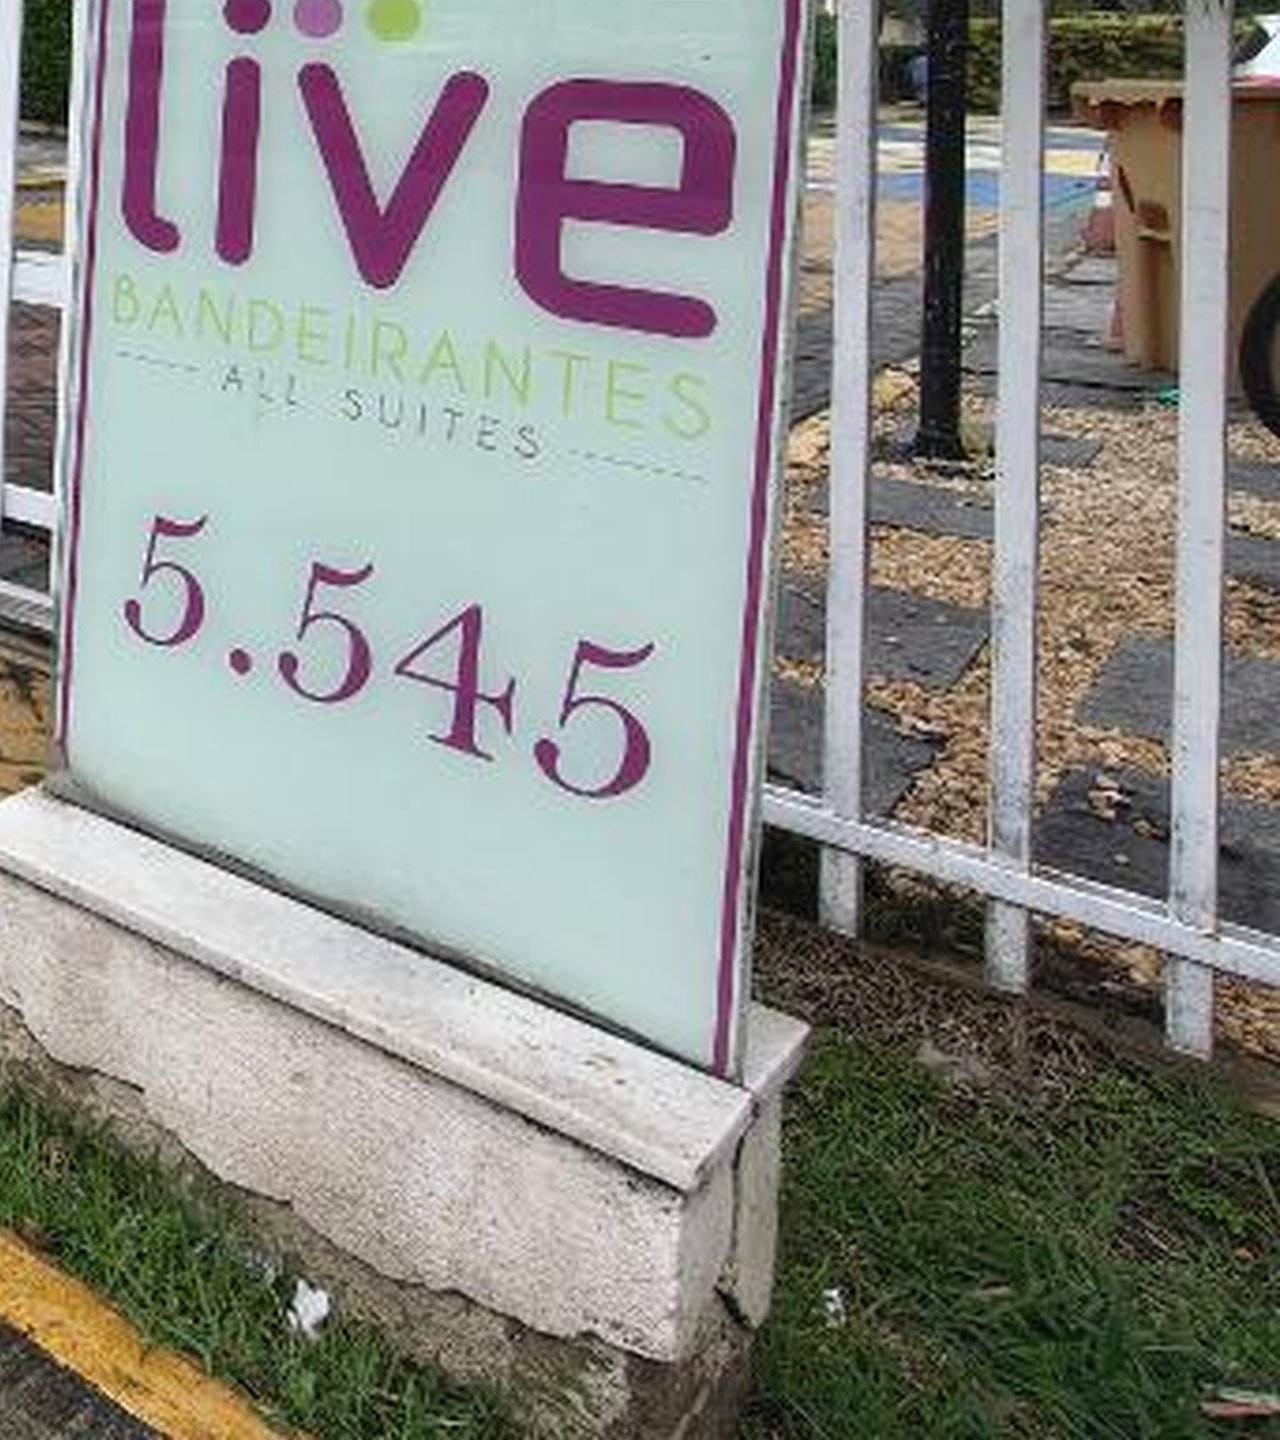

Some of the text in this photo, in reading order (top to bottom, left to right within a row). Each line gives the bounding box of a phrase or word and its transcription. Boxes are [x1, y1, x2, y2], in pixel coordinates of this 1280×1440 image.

[112, 274, 715, 442] BANDEIRANTES
[219, 363, 542, 462] ALL SUITES
[123, 515, 657, 799] 5.545
